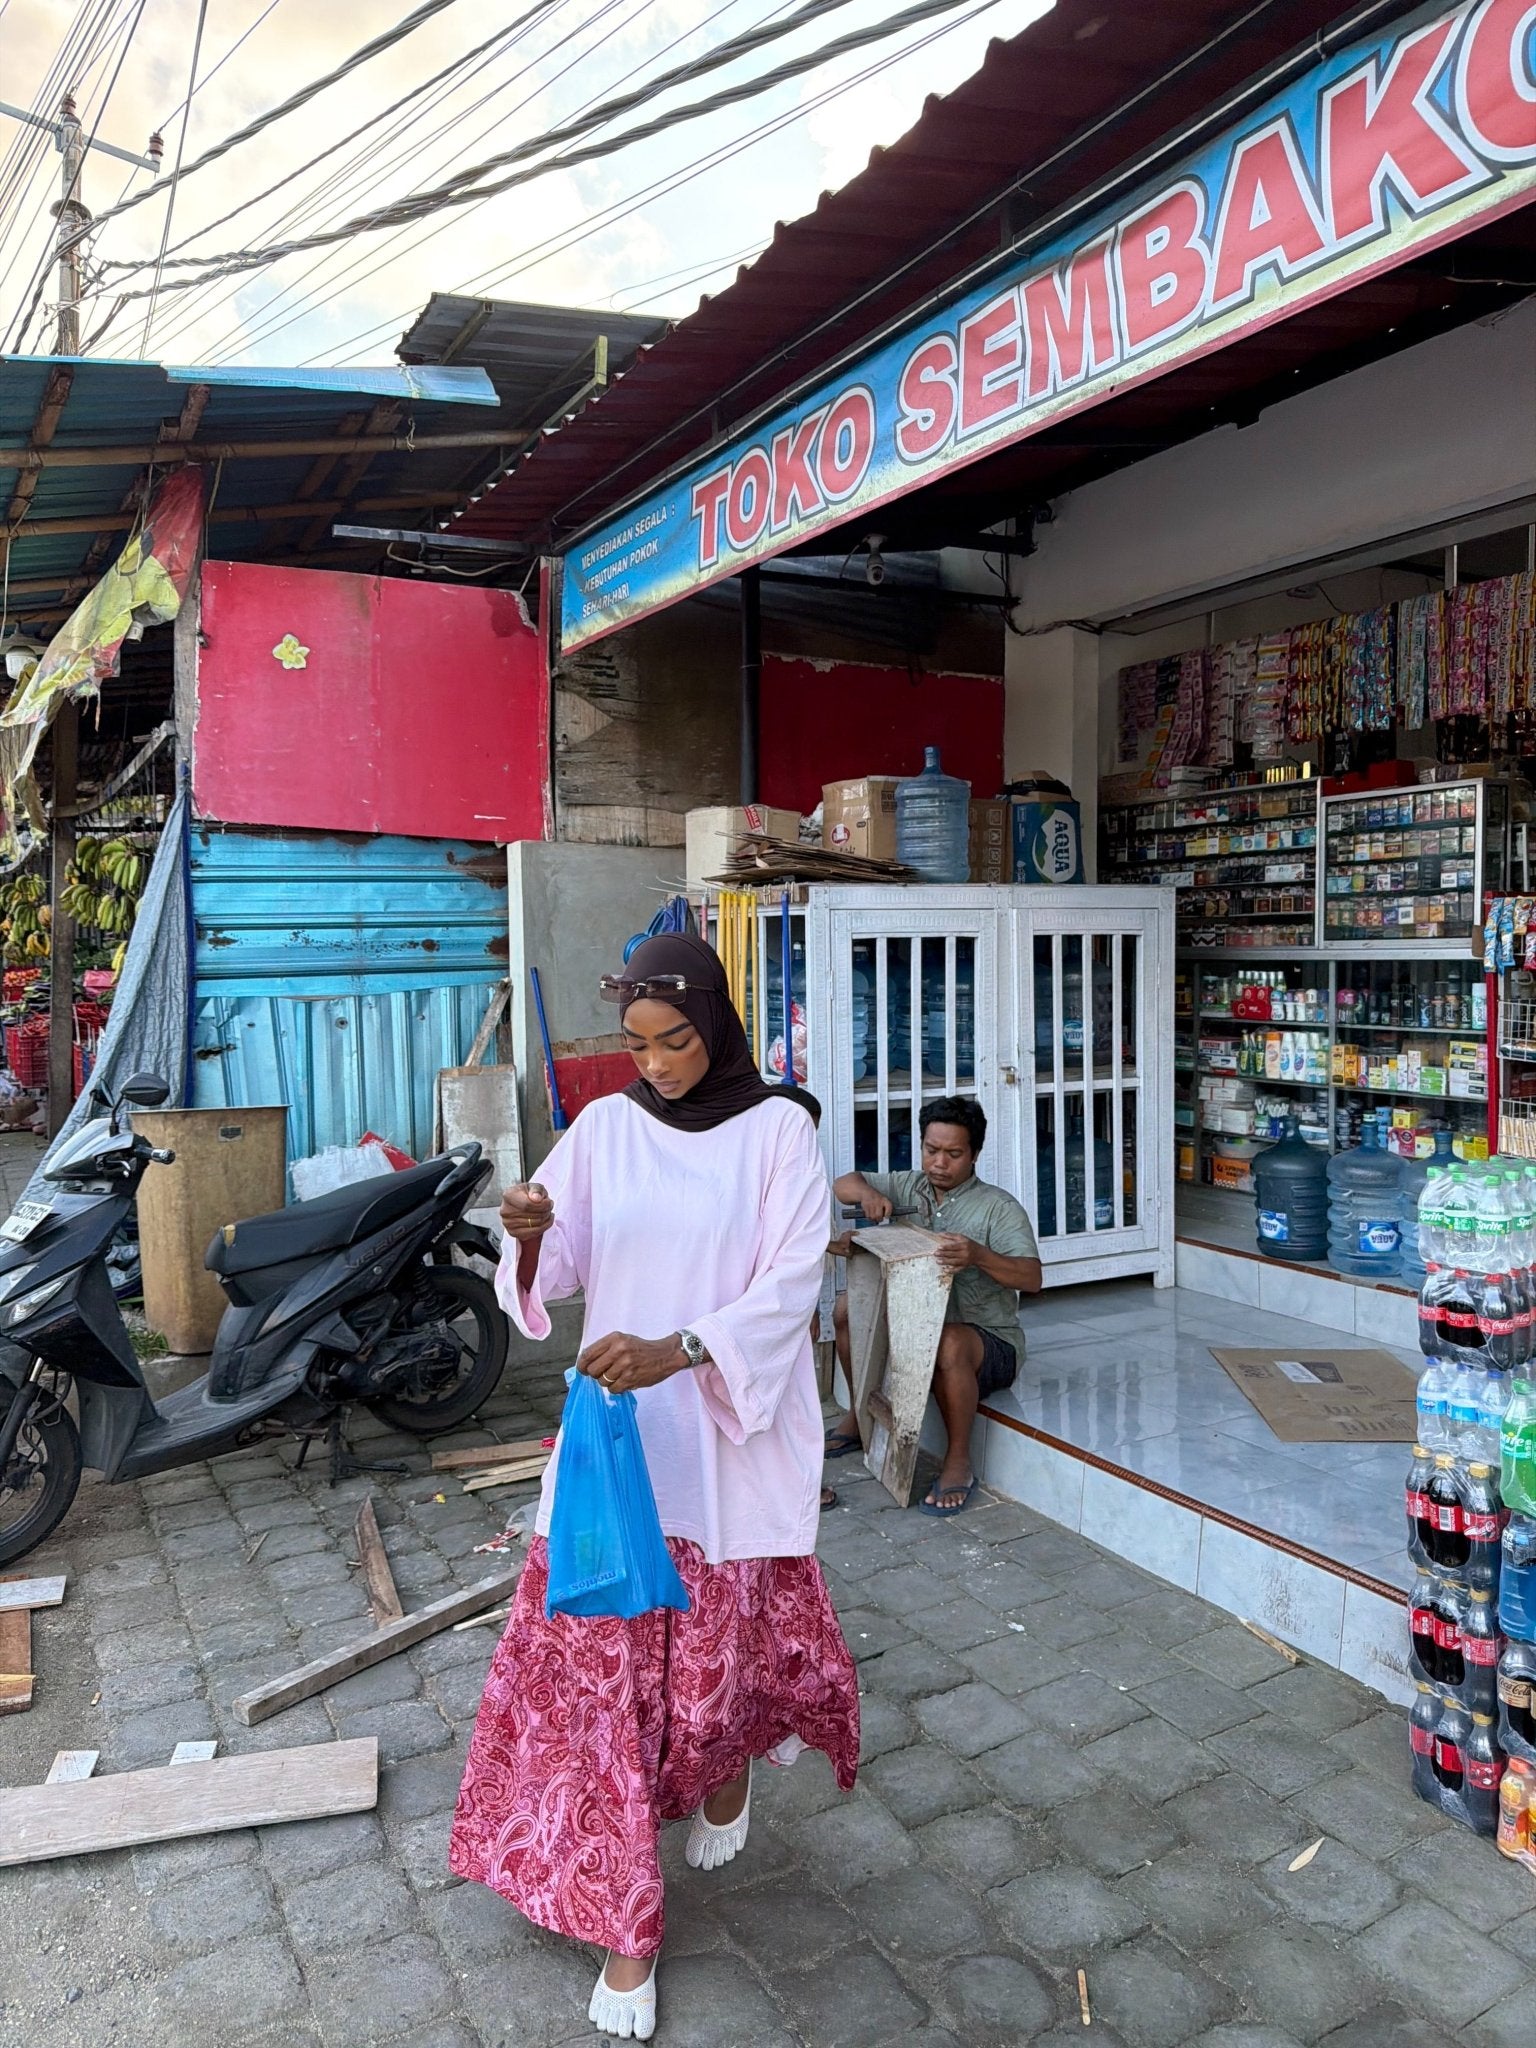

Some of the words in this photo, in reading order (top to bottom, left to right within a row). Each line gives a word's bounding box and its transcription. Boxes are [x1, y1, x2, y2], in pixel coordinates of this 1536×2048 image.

[691, 383, 877, 571] TOKO
[581, 525, 634, 570] MENYEDIAKAN
[635, 506, 667, 537] SEGALA
[584, 559, 628, 593] KEBUTUHAN
[629, 537, 659, 567] POKOK
[582, 582, 630, 618] SEHARI-HARI
[1051, 819, 1070, 874] AQUA
[1370, 1233, 1395, 1244] AQUA
[1476, 1220, 1503, 1231] Sprite
[1516, 1217, 1532, 1228] Spr
